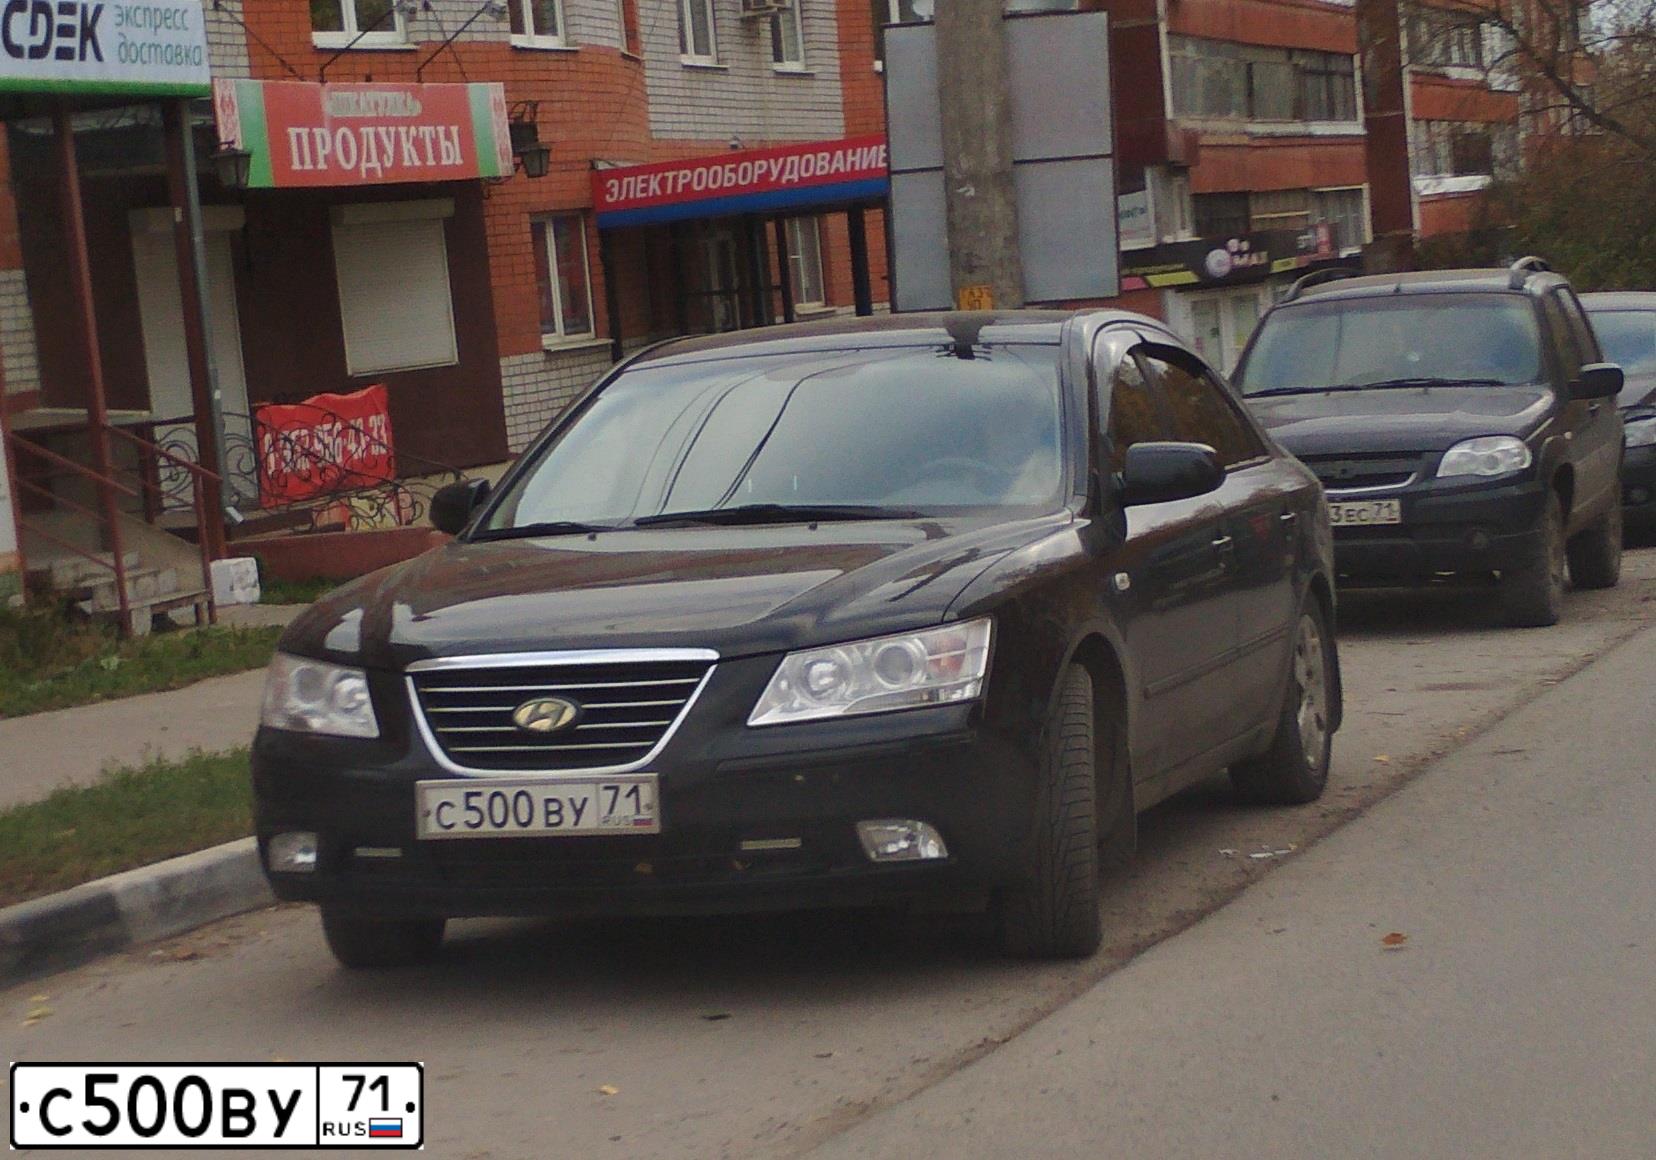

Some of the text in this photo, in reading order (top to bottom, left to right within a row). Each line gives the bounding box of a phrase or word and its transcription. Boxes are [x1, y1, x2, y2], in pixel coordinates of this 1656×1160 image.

[2, 1, 105, 63] CDEK
[114, 4, 190, 35] экспресс
[118, 32, 203, 67] доставка
[287, 125, 464, 178] ПРОДУКТЫ
[605, 144, 888, 203] ЭЛЕКТРООБОРУДОВАНИЕ
[602, 784, 642, 816] 71
